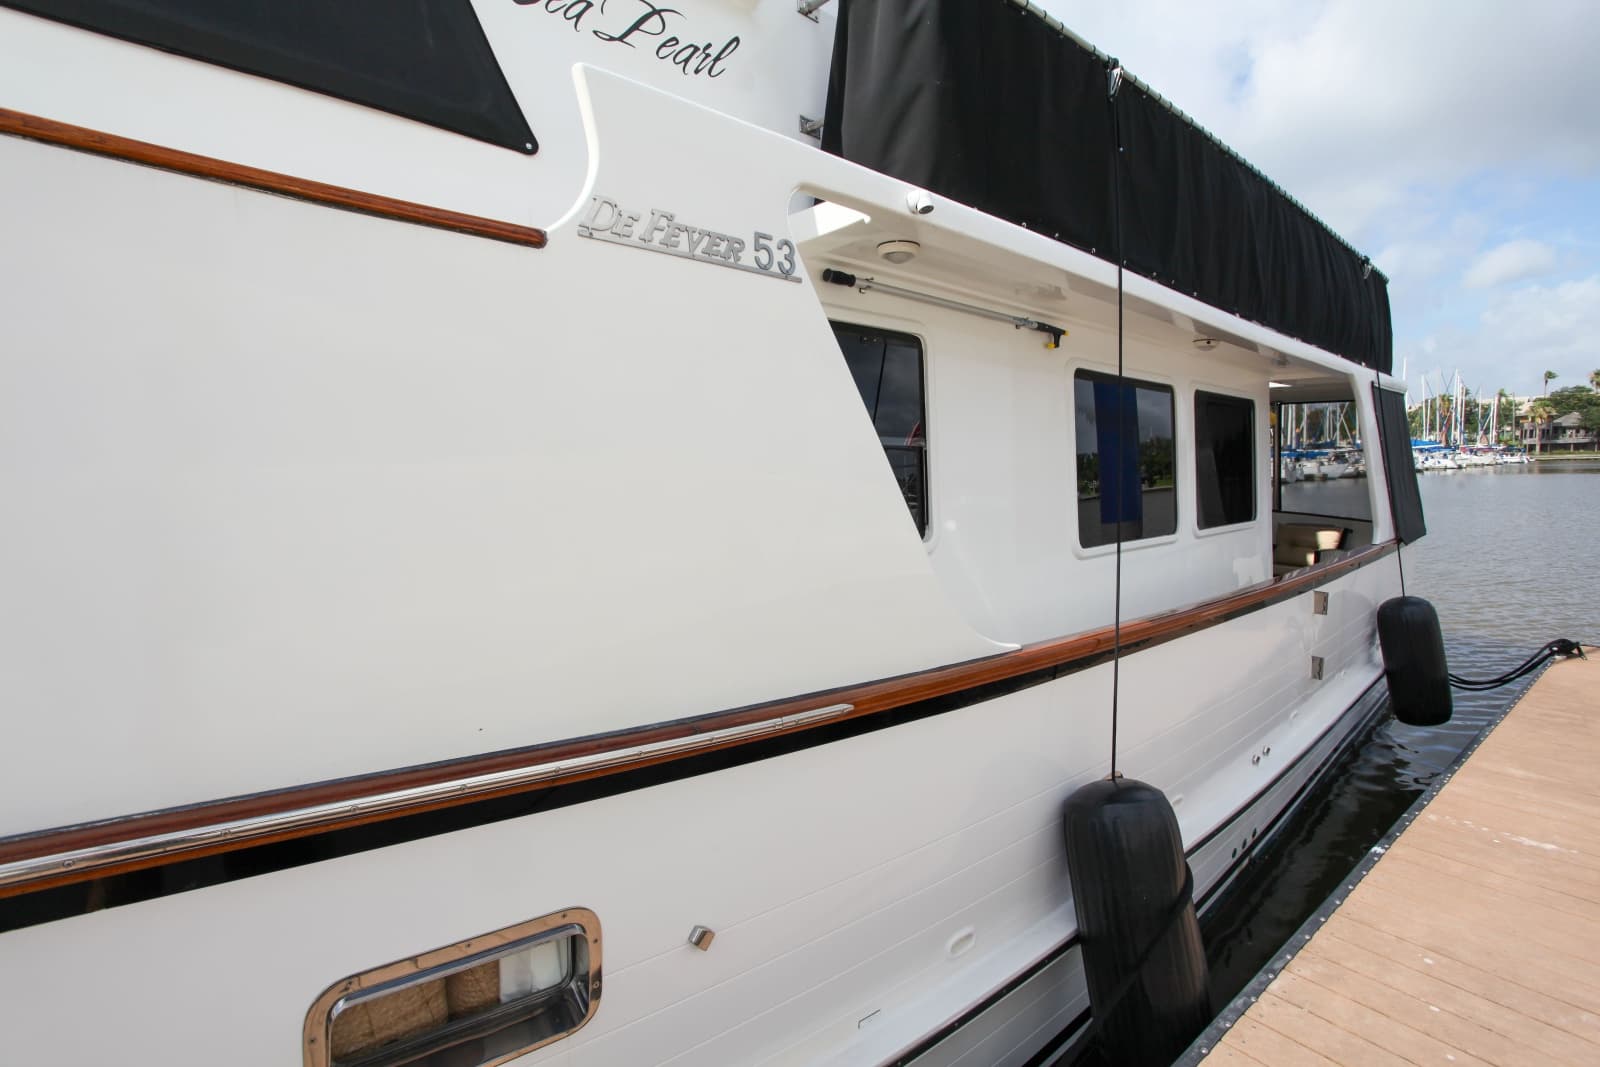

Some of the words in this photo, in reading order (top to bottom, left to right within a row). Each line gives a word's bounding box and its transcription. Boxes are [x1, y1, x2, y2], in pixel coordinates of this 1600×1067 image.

[511, 0, 594, 32] ea
[592, 0, 741, 78] Pearl
[639, 208, 746, 264] FEVER
[753, 231, 796, 275] 53
